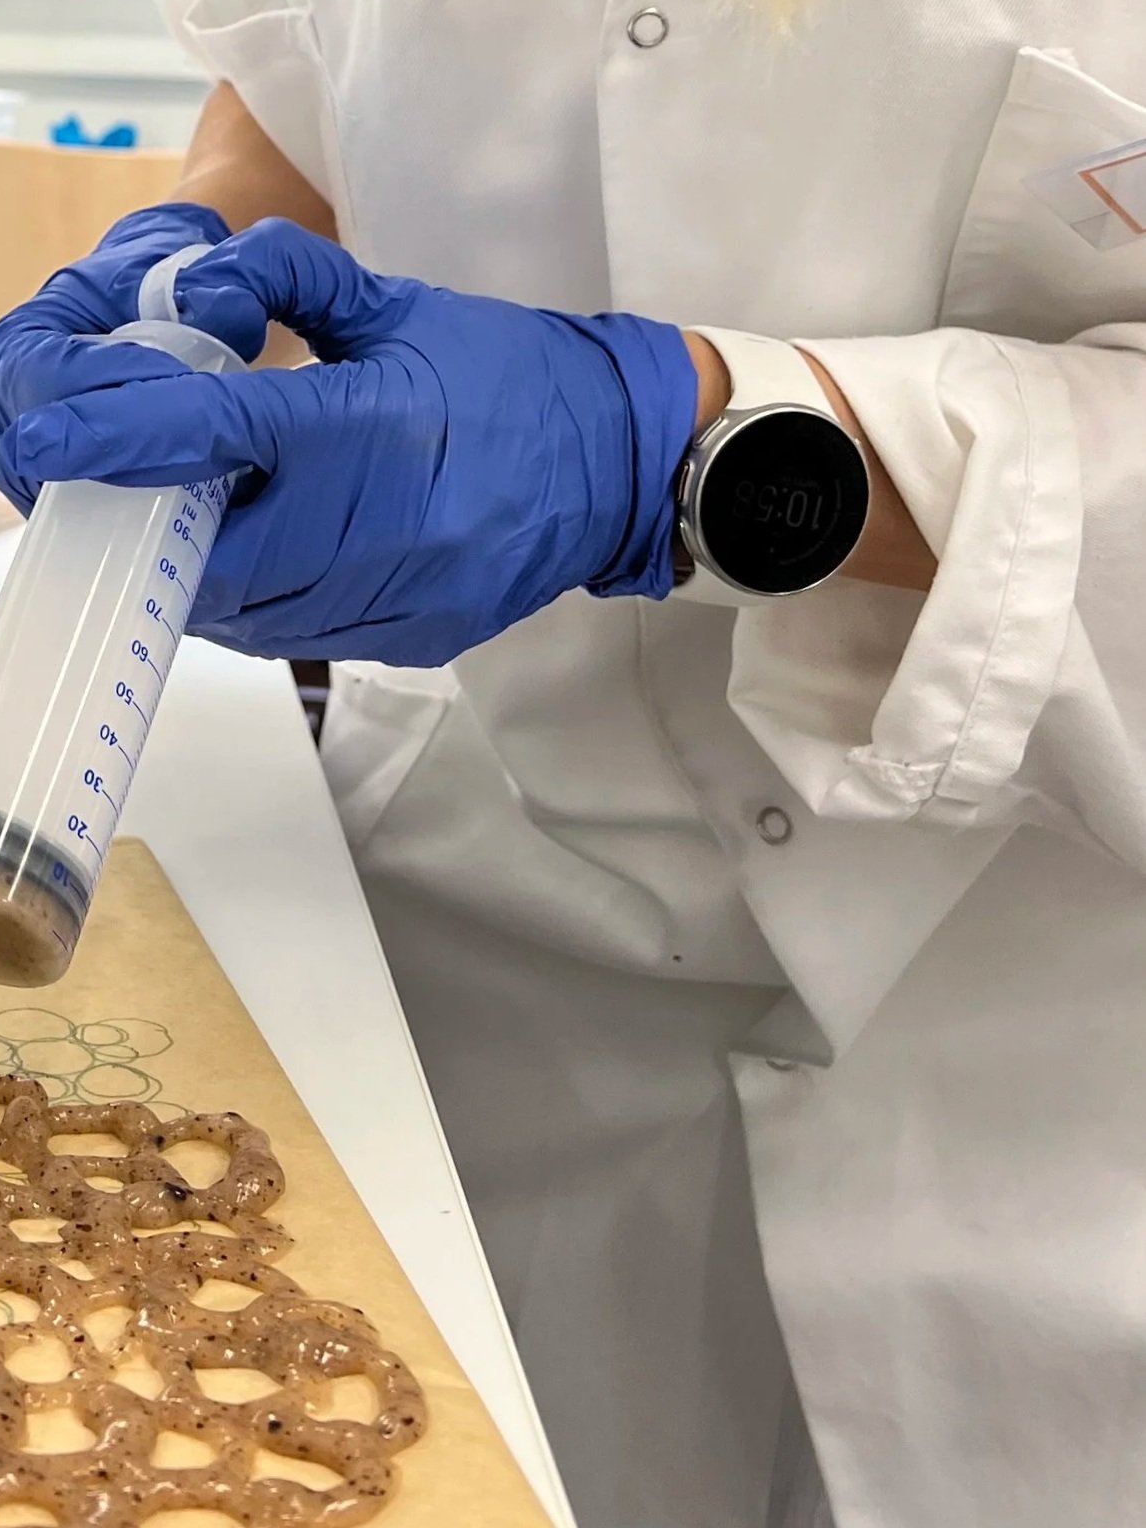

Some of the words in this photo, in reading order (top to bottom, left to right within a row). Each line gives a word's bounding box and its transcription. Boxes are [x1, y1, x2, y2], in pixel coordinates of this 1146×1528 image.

[182, 502, 197, 521] ml
[174, 519, 190, 541] 90
[159, 558, 177, 580] 80
[146, 598, 163, 622] 70
[131, 640, 148, 662] 60
[116, 681, 134, 705] 50
[100, 724, 118, 746] 40
[84, 769, 103, 793] 30
[68, 815, 88, 839] 20
[53, 861, 70, 886] 10
